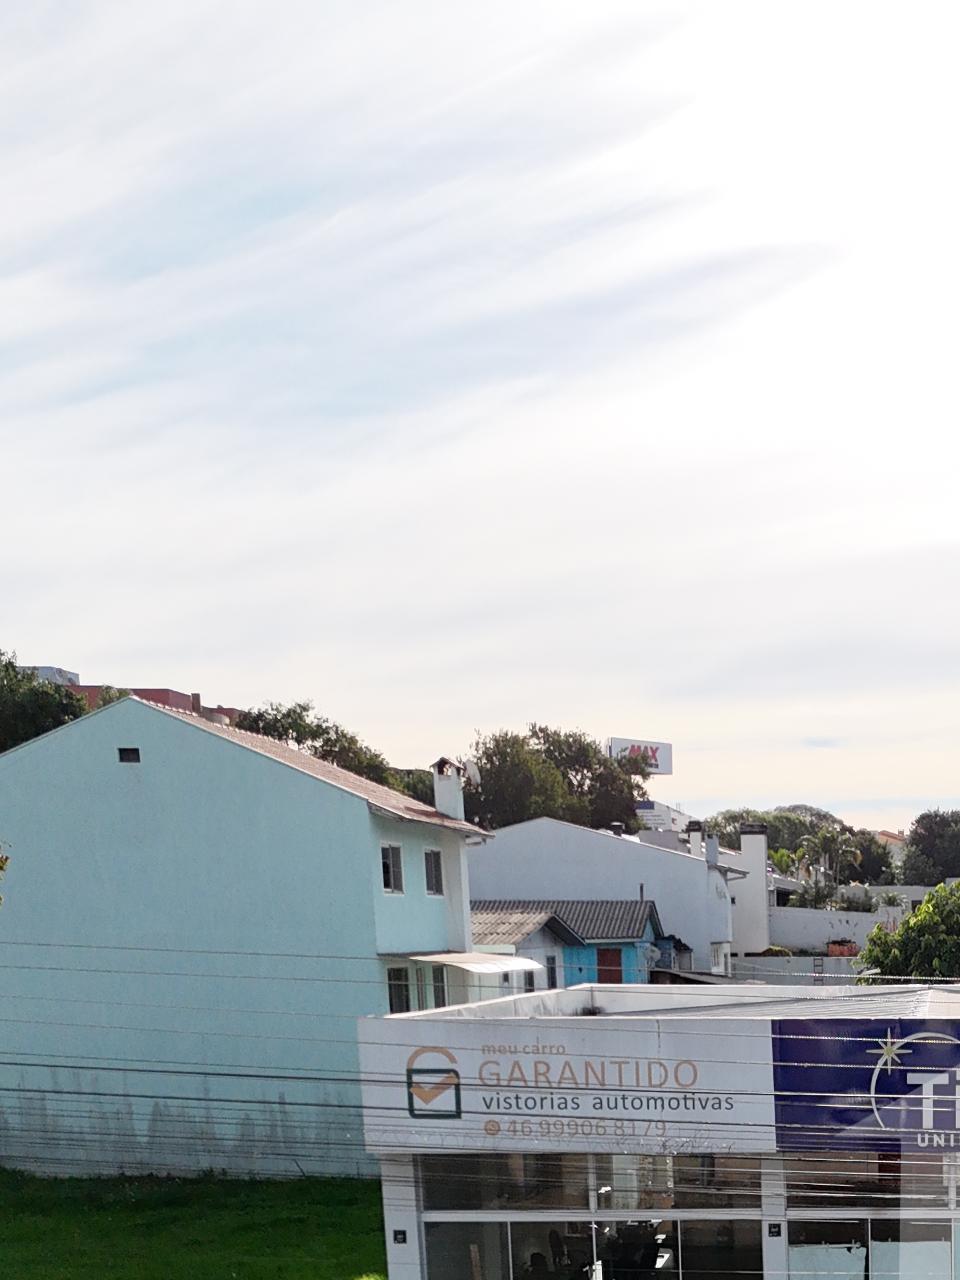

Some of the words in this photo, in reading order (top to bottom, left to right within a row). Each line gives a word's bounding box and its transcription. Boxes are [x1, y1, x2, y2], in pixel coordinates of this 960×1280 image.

[482, 1044, 517, 1055] meu
[522, 1043, 566, 1055] carro
[478, 1060, 698, 1088] GARANTIDO
[482, 1092, 581, 1111] vistorias
[592, 1092, 734, 1112] automotivas
[506, 1119, 533, 1137] 46
[538, 1119, 609, 1137] 99906
